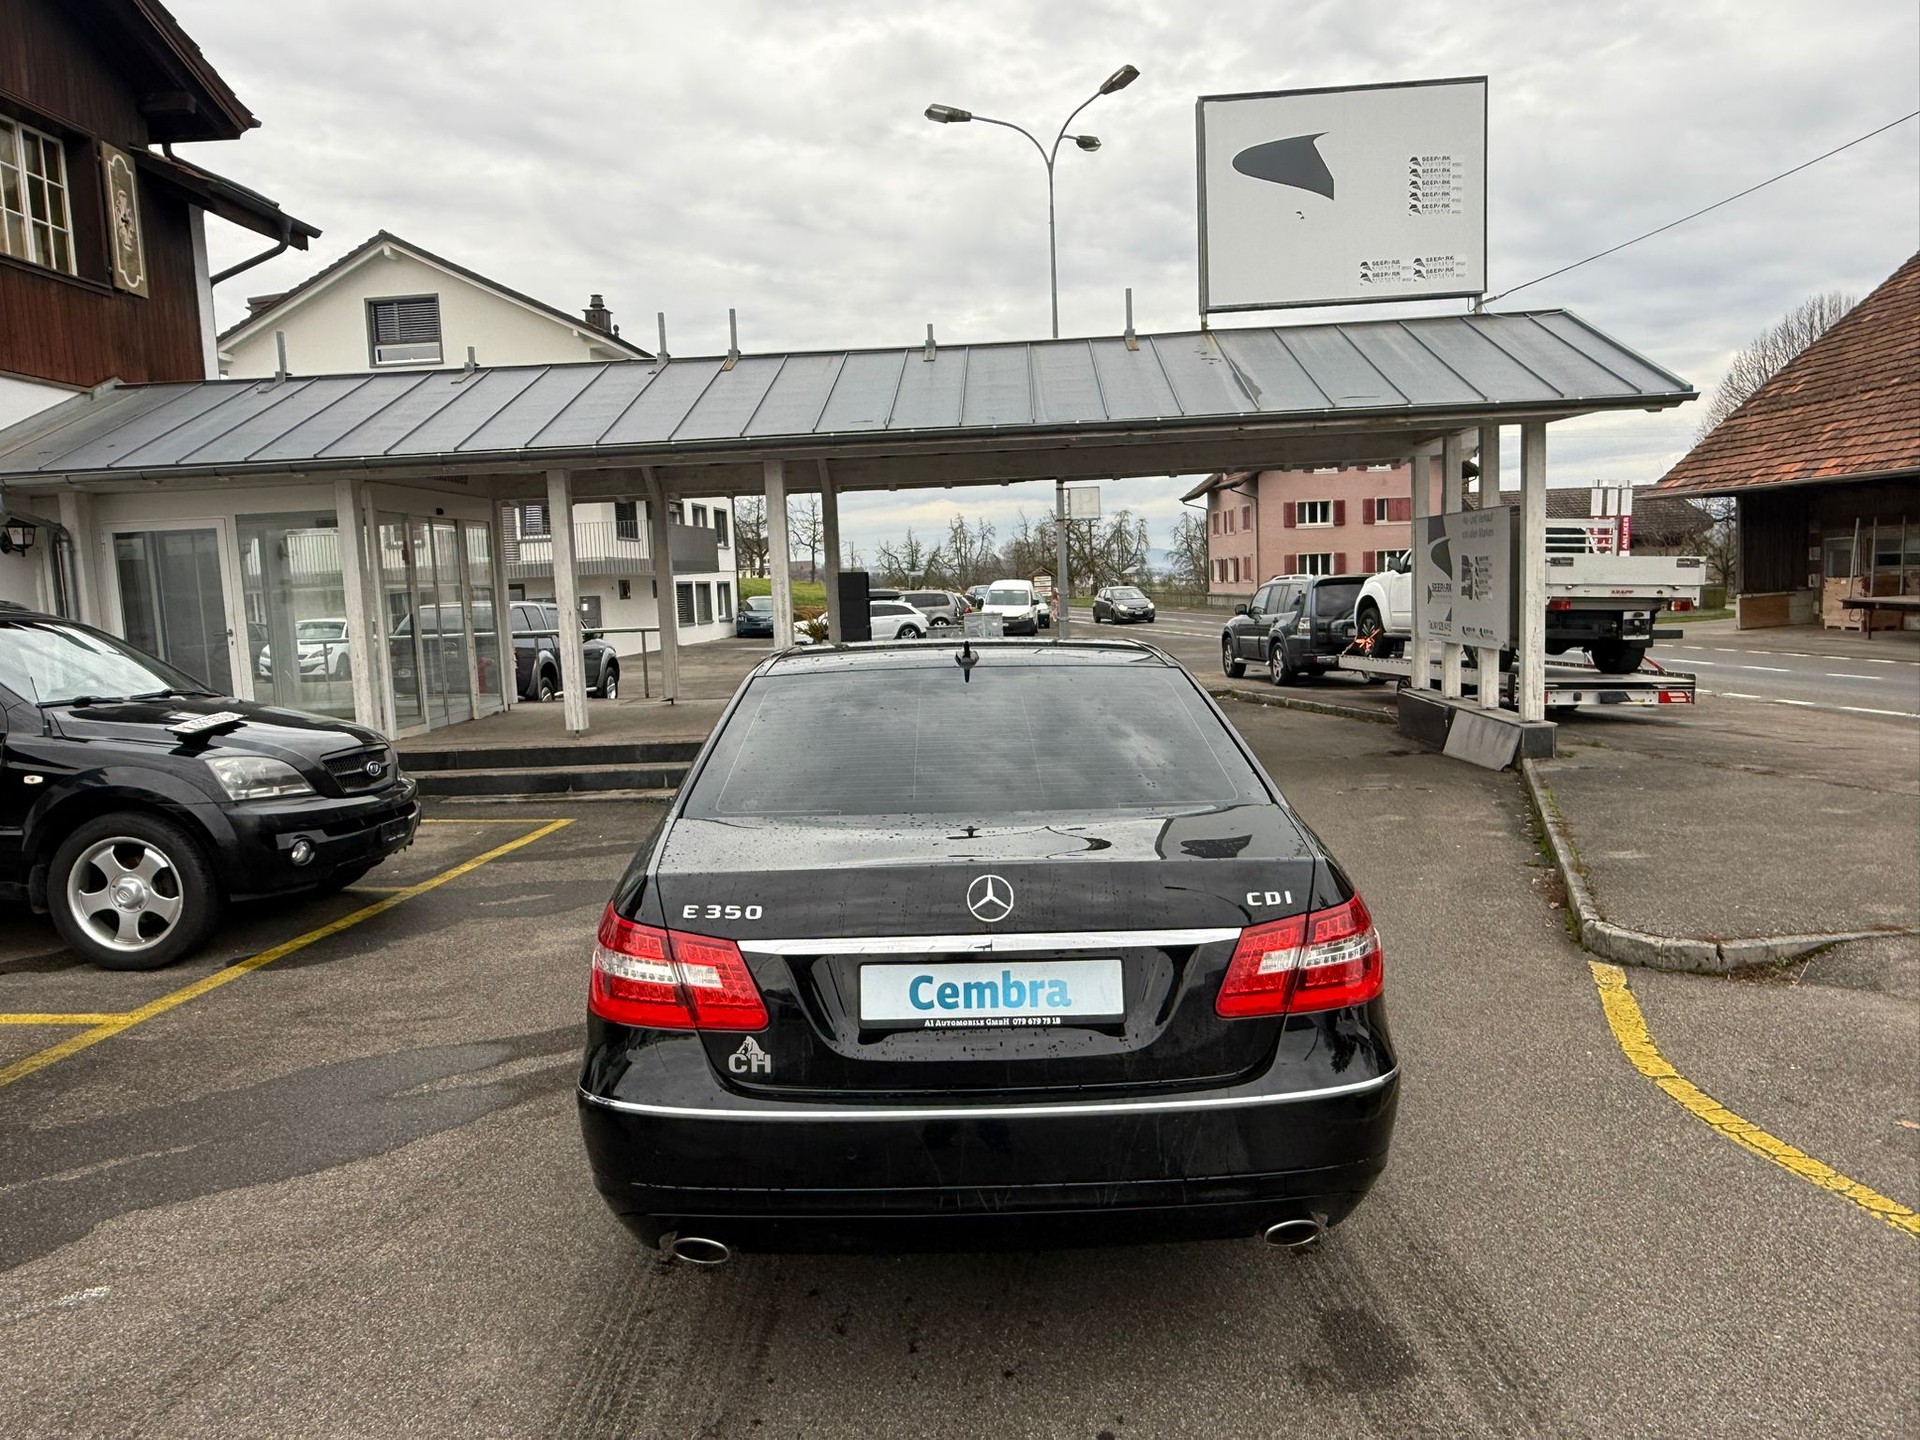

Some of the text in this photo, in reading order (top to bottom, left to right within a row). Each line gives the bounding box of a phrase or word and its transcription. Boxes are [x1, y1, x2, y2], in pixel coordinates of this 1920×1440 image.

[1246, 890, 1293, 906] CDI
[682, 904, 763, 920] E 350
[909, 970, 1072, 1010] Cembra
[728, 1053, 772, 1073] CH
